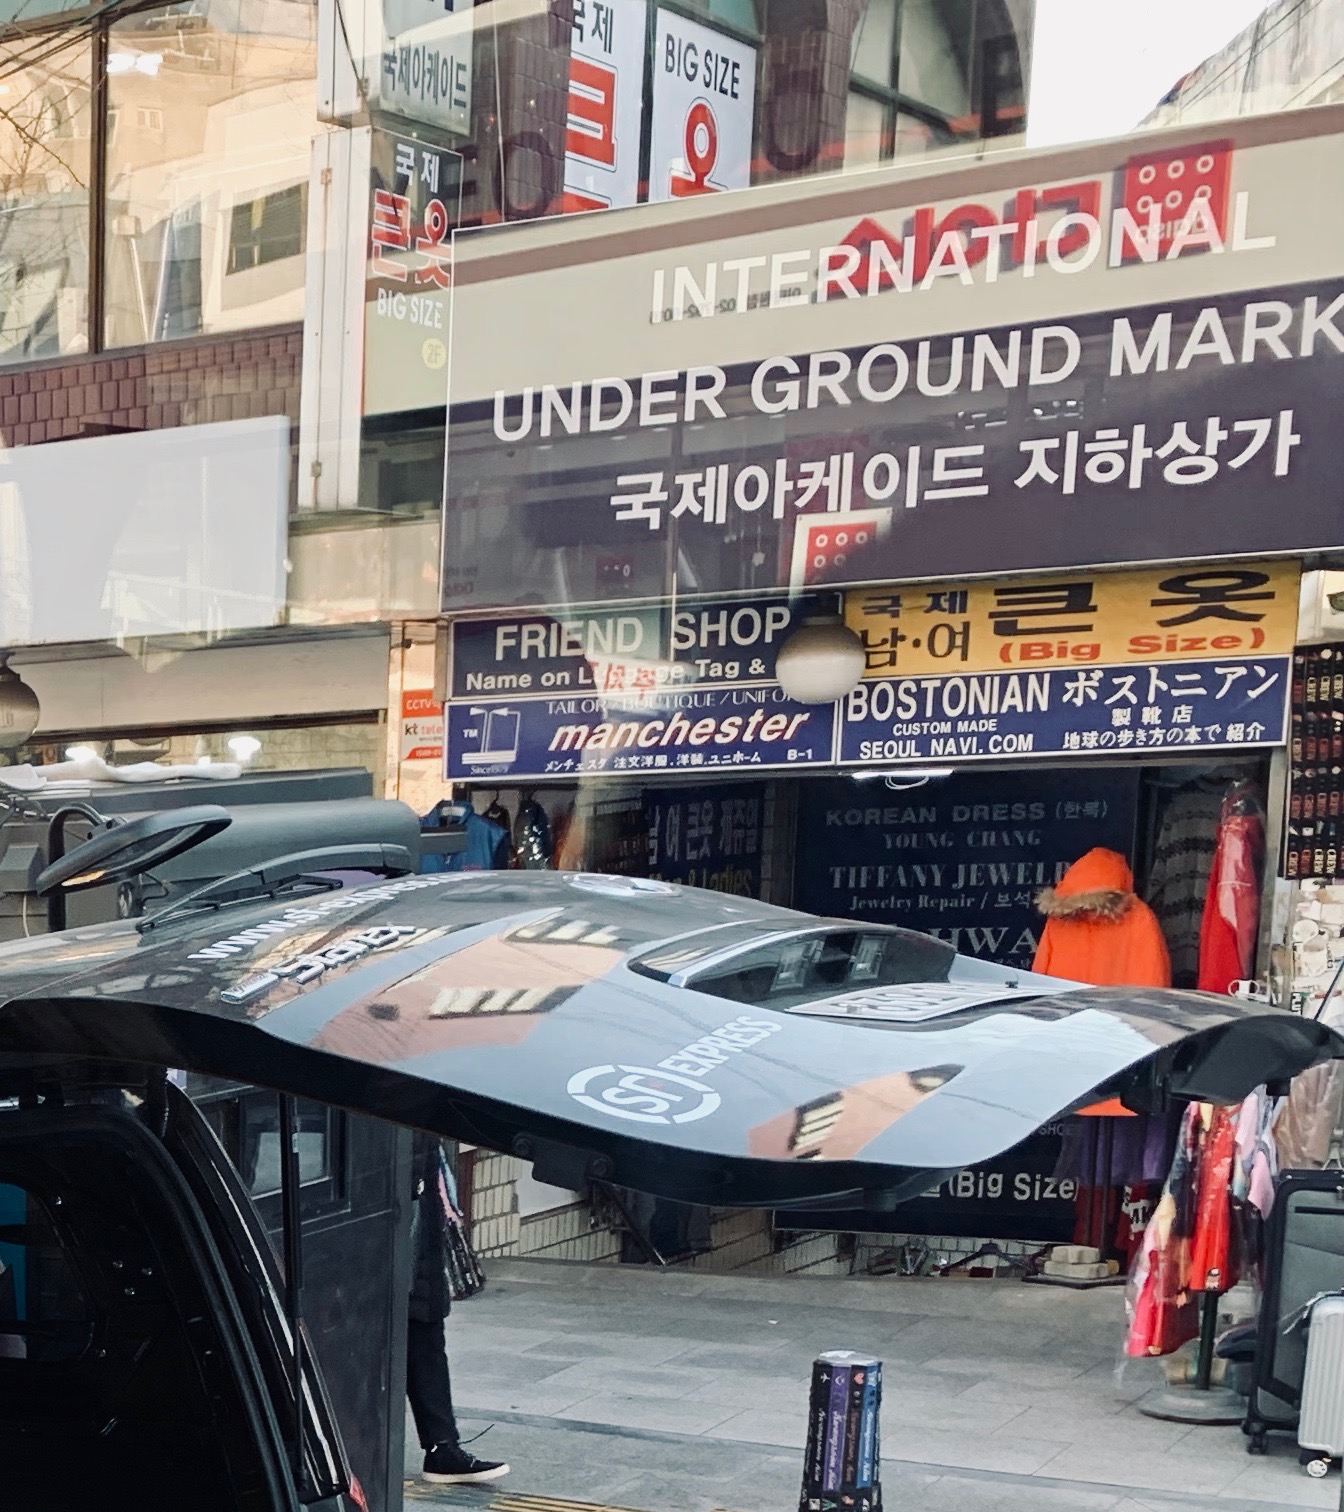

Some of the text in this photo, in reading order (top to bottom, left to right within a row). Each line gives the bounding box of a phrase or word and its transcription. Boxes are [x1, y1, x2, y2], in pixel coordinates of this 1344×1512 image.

[665, 33, 740, 99] BIG SIZE
[396, 144, 441, 194] 국제
[649, 190, 1277, 326] INTERNATIONAL
[376, 286, 443, 329] BIG SIZE
[493, 366, 727, 442] UNDER
[750, 324, 1083, 418] GROUND
[610, 409, 1303, 530] 국제아케이드 지하상가
[860, 588, 969, 620] 국제
[495, 606, 792, 661] FRIEND SHOP
[998, 627, 1266, 663] (Big Size)
[466, 672, 533, 692] Name
[540, 670, 571, 688] on
[695, 657, 740, 681] Tag
[748, 656, 767, 676] &
[1061, 665, 1281, 706] ボストニアン
[847, 674, 1052, 722] BOSTONIAN
[548, 708, 811, 752] manchester
[893, 719, 999, 737] CUSTOM MADE
[786, 748, 813, 763] B-1
[859, 740, 922, 760] SEOUL
[825, 806, 937, 827] KOREAN
[952, 801, 1046, 822] DRESS
[883, 829, 1043, 850] YOUNG CHANG
[829, 863, 946, 890] TIFFANY
[849, 895, 913, 912] Jewelry
[918, 893, 976, 911] Repair
[656, 1015, 784, 1078] EXPRESS
[948, 1169, 1080, 1202] (Big Size)
